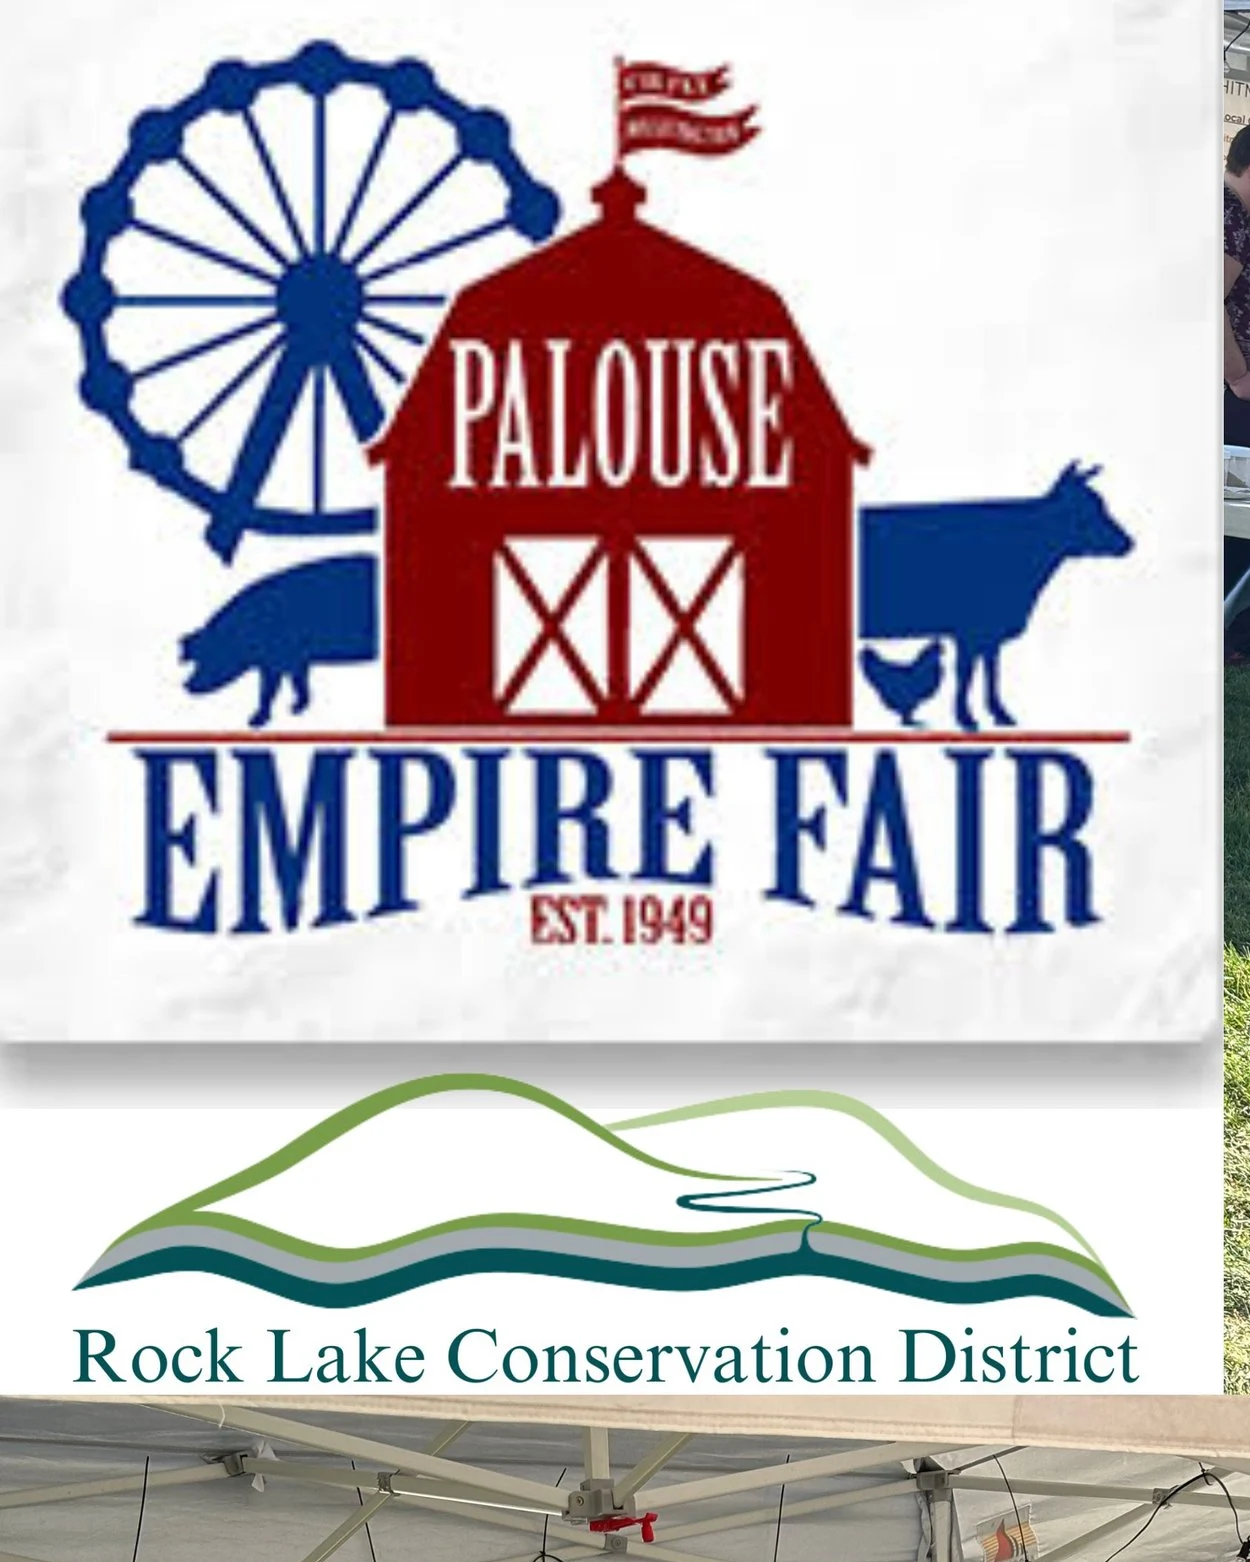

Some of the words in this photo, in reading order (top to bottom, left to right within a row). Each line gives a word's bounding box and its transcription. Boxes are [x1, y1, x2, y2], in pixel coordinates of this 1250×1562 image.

[448, 338, 796, 490] PALOUSE
[133, 746, 716, 936] EMPIRE
[763, 746, 1105, 936] FAIR
[530, 896, 614, 945] EST.
[621, 896, 714, 945] 1949
[73, 1328, 242, 1384] Rock
[267, 1328, 426, 1384] Lake
[446, 1328, 875, 1384] Conservation
[898, 1328, 1141, 1384] District
